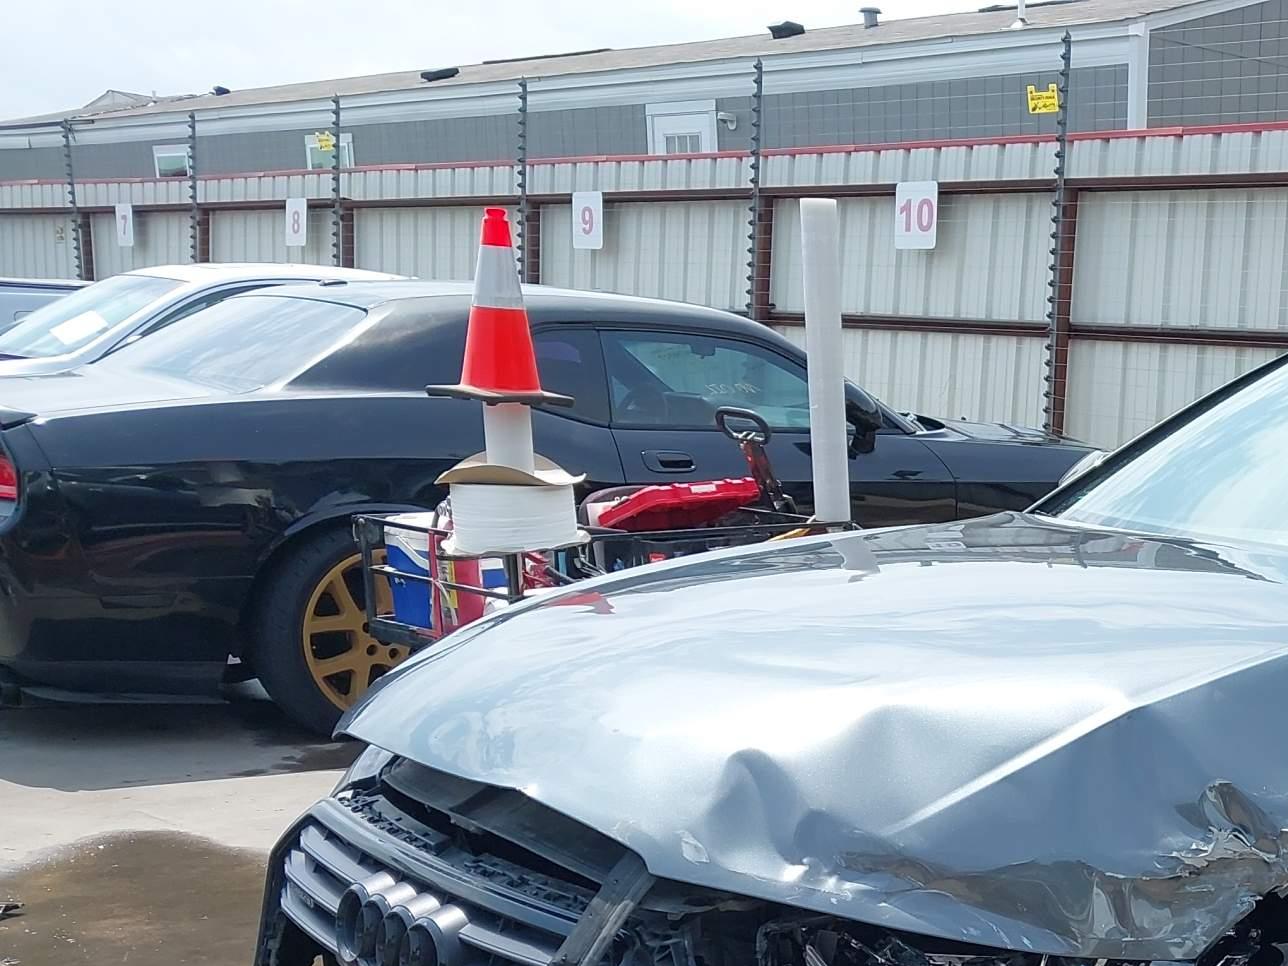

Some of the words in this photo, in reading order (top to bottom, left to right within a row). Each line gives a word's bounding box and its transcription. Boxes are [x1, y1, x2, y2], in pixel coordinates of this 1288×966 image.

[121, 214, 128, 236] 7
[292, 210, 300, 234] 8
[581, 206, 594, 235] 9
[899, 198, 934, 233] 10
